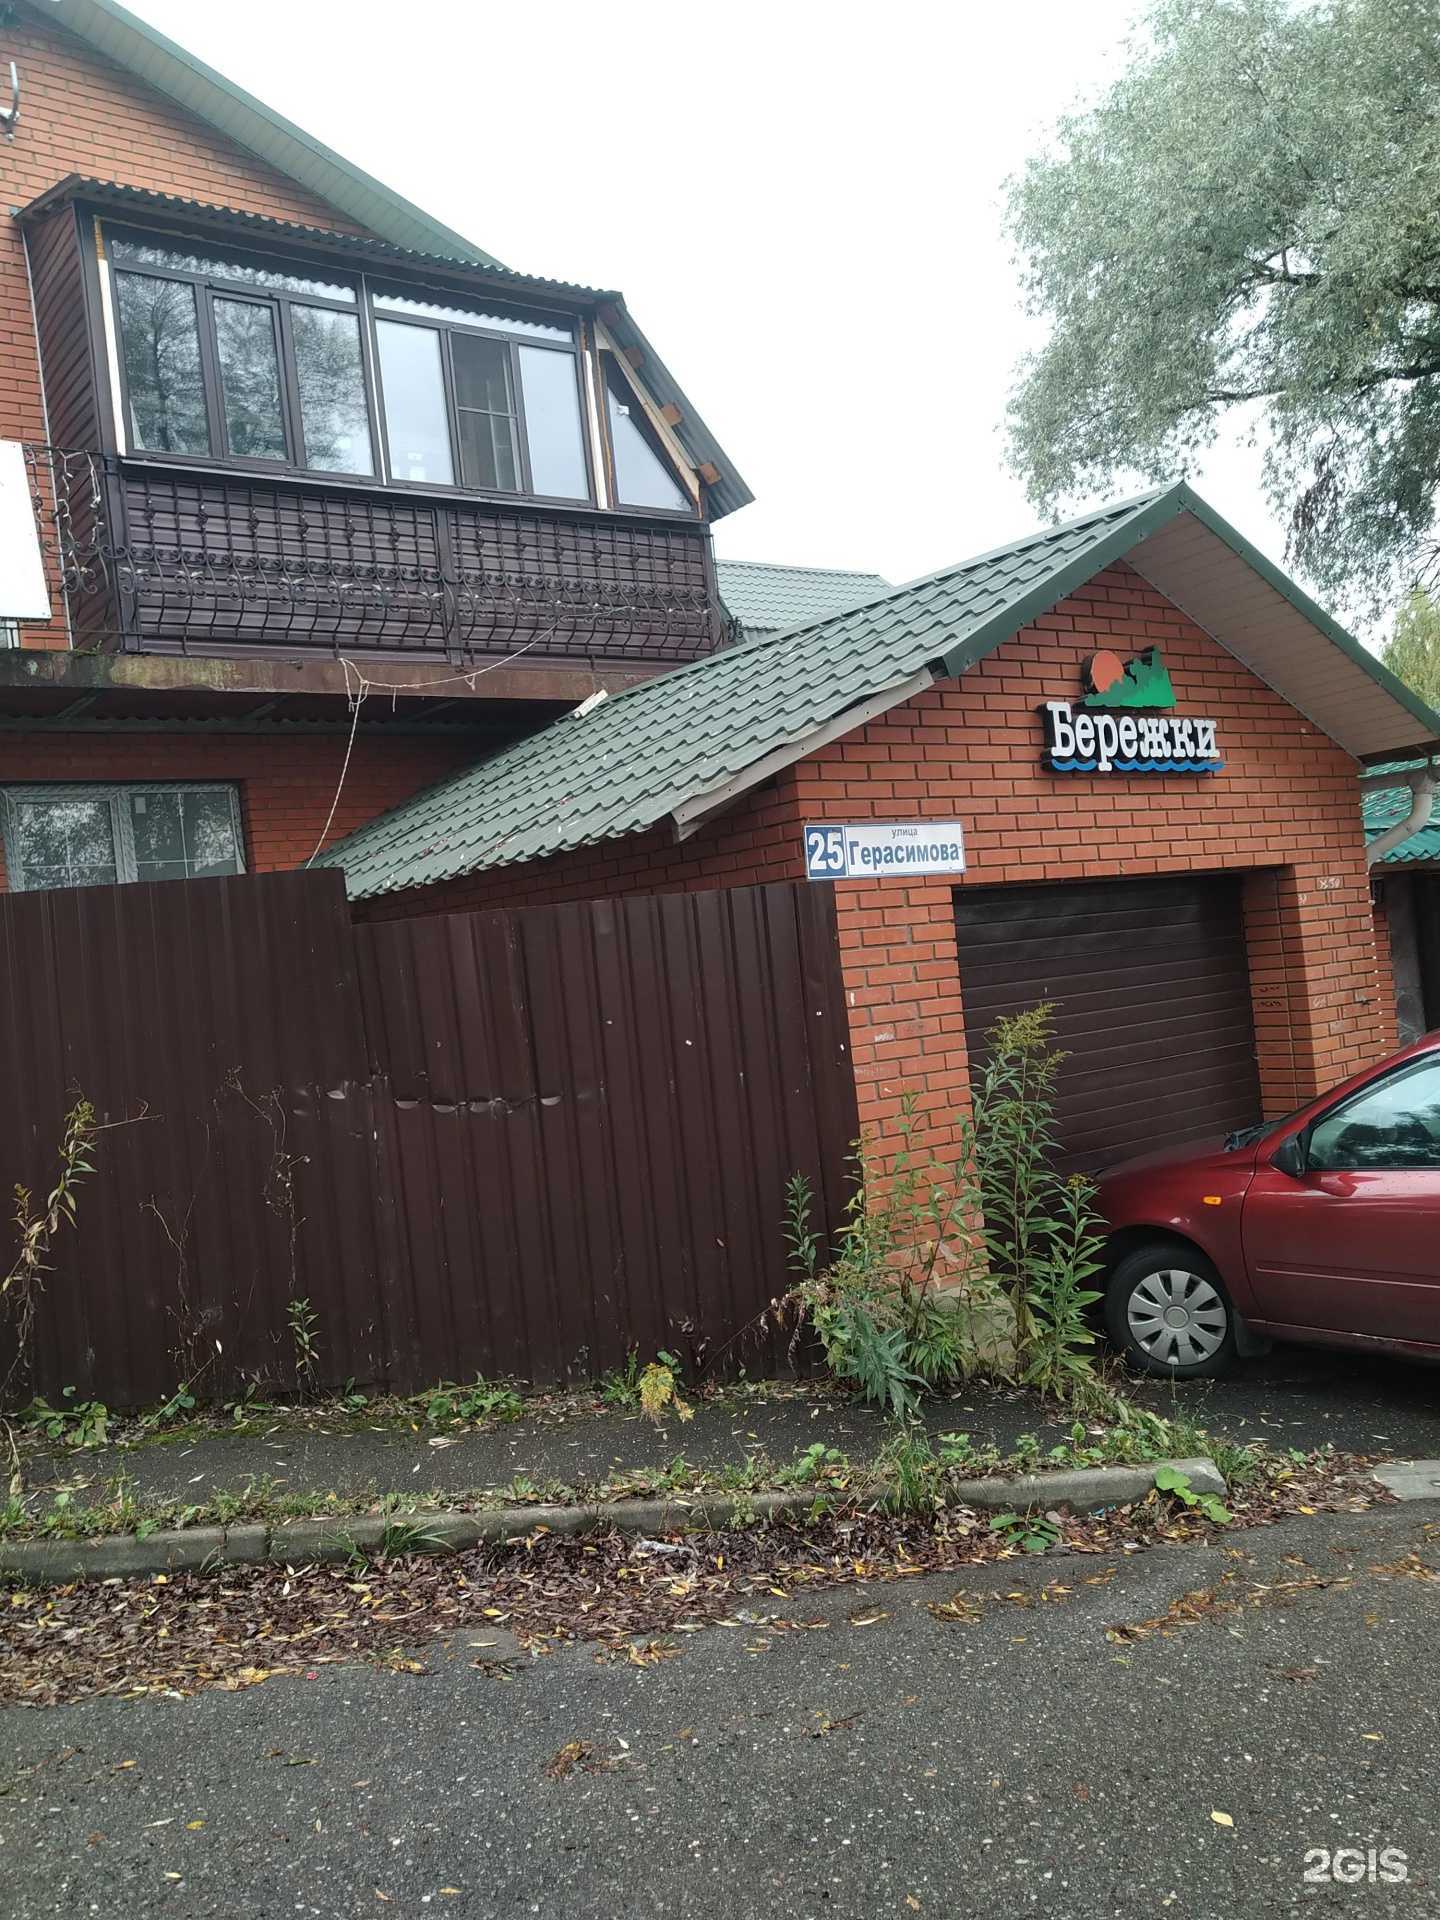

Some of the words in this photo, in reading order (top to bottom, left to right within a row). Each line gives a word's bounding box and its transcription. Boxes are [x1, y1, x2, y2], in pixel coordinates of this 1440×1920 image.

[1046, 701, 1220, 771] Бережки
[891, 827, 918, 839] улица
[808, 832, 844, 870] 25
[848, 842, 960, 870] Герасимова
